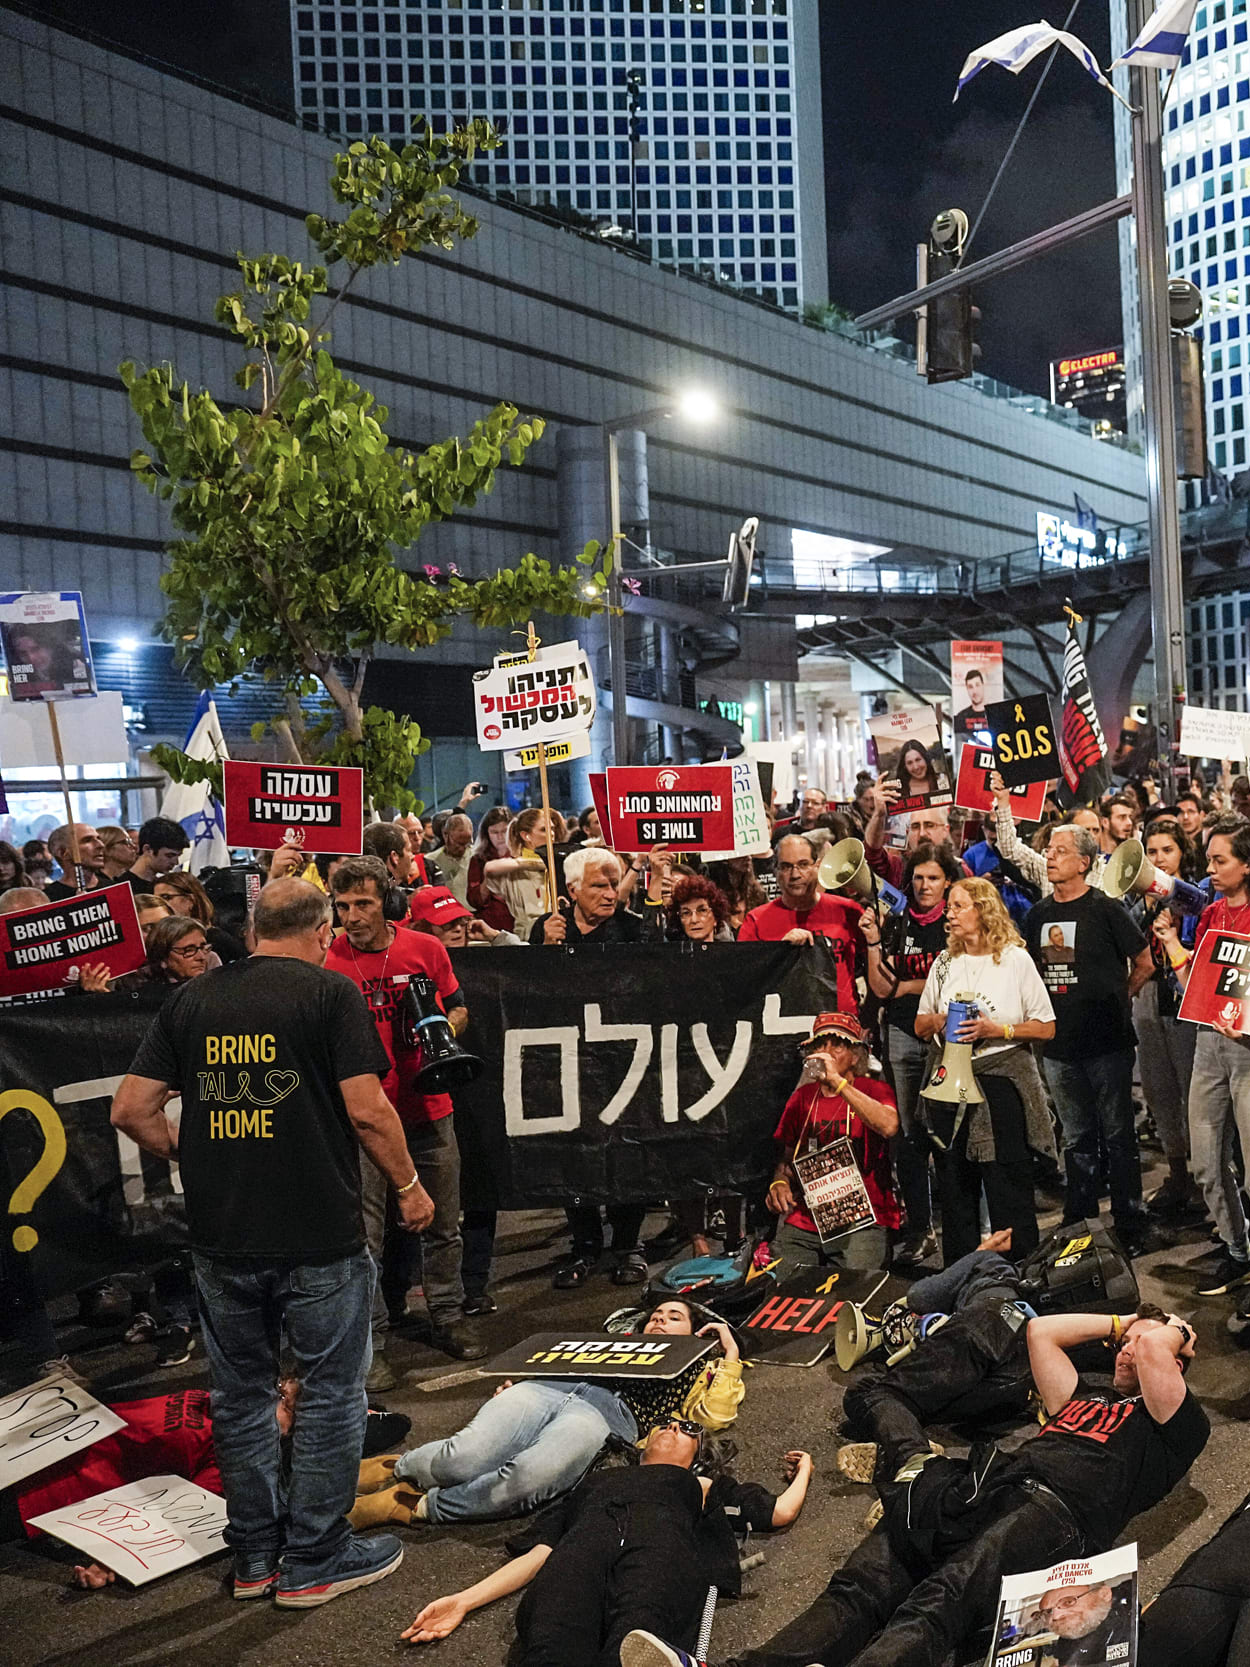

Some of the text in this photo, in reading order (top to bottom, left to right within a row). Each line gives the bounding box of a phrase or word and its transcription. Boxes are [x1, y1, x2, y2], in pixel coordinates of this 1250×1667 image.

[1069, 351, 1117, 372] ELECTRA
[11, 663, 34, 674] BRING
[480, 684, 577, 714] המכשול
[501, 694, 593, 731] לעסקה
[996, 725, 1052, 763] S.O.S
[266, 771, 332, 797] עסקה
[254, 800, 333, 823] עכשיו!
[618, 795, 722, 819] RUNNING OUT!
[642, 822, 697, 840] TIME IS
[13, 902, 110, 941] BRING THEM
[14, 920, 119, 964] HOME NOW!!!
[206, 1034, 277, 1065] BRING
[209, 1109, 274, 1140] HOME
[1046, 1572, 1064, 1583] ALEX
[1061, 1577, 1076, 1586] (75)
[995, 1648, 1033, 1667] BRING
